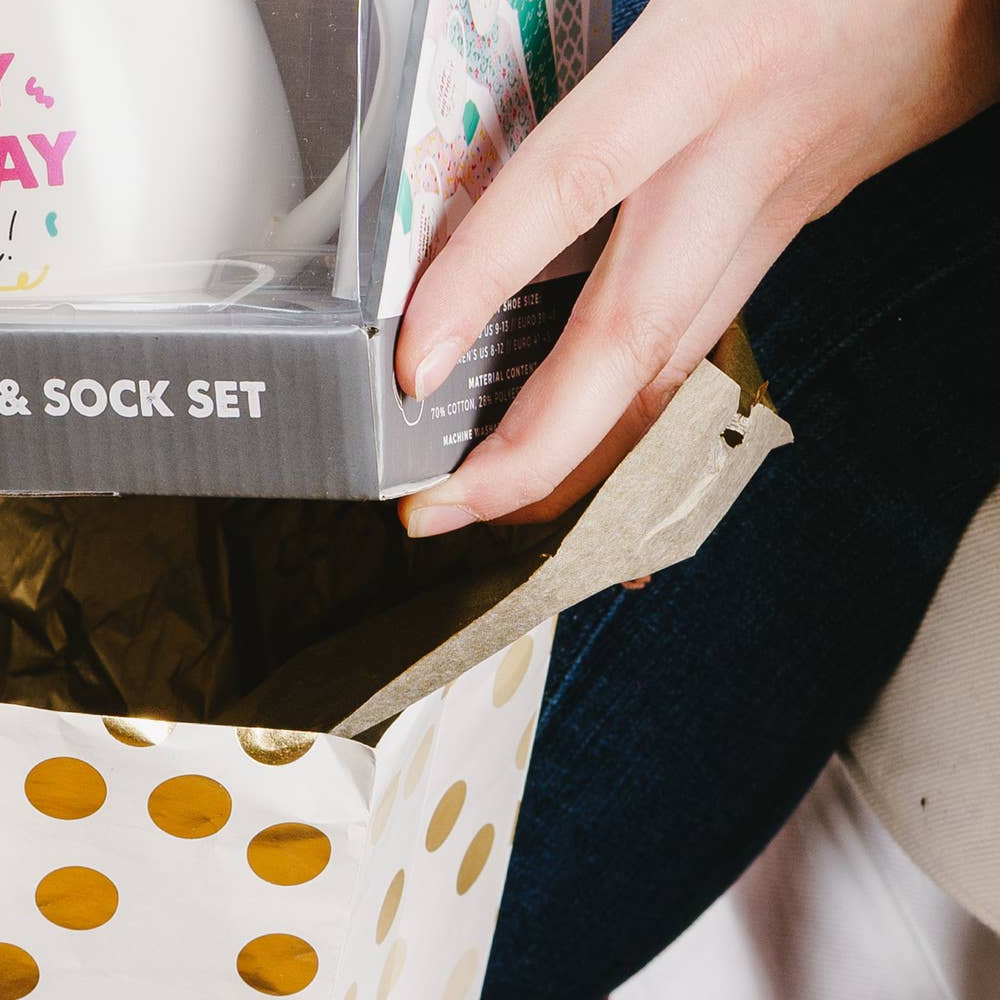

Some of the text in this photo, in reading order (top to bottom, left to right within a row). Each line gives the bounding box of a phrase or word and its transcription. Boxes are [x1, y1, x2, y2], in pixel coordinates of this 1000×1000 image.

[503, 297, 521, 312] SHOE
[484, 324, 493, 337] US
[480, 346, 488, 359] US
[468, 371, 504, 389] MATERIAL
[44, 378, 174, 418] SOCK
[188, 380, 266, 419] SET
[430, 406, 446, 420] 70%
[443, 428, 473, 446] MACHINE
